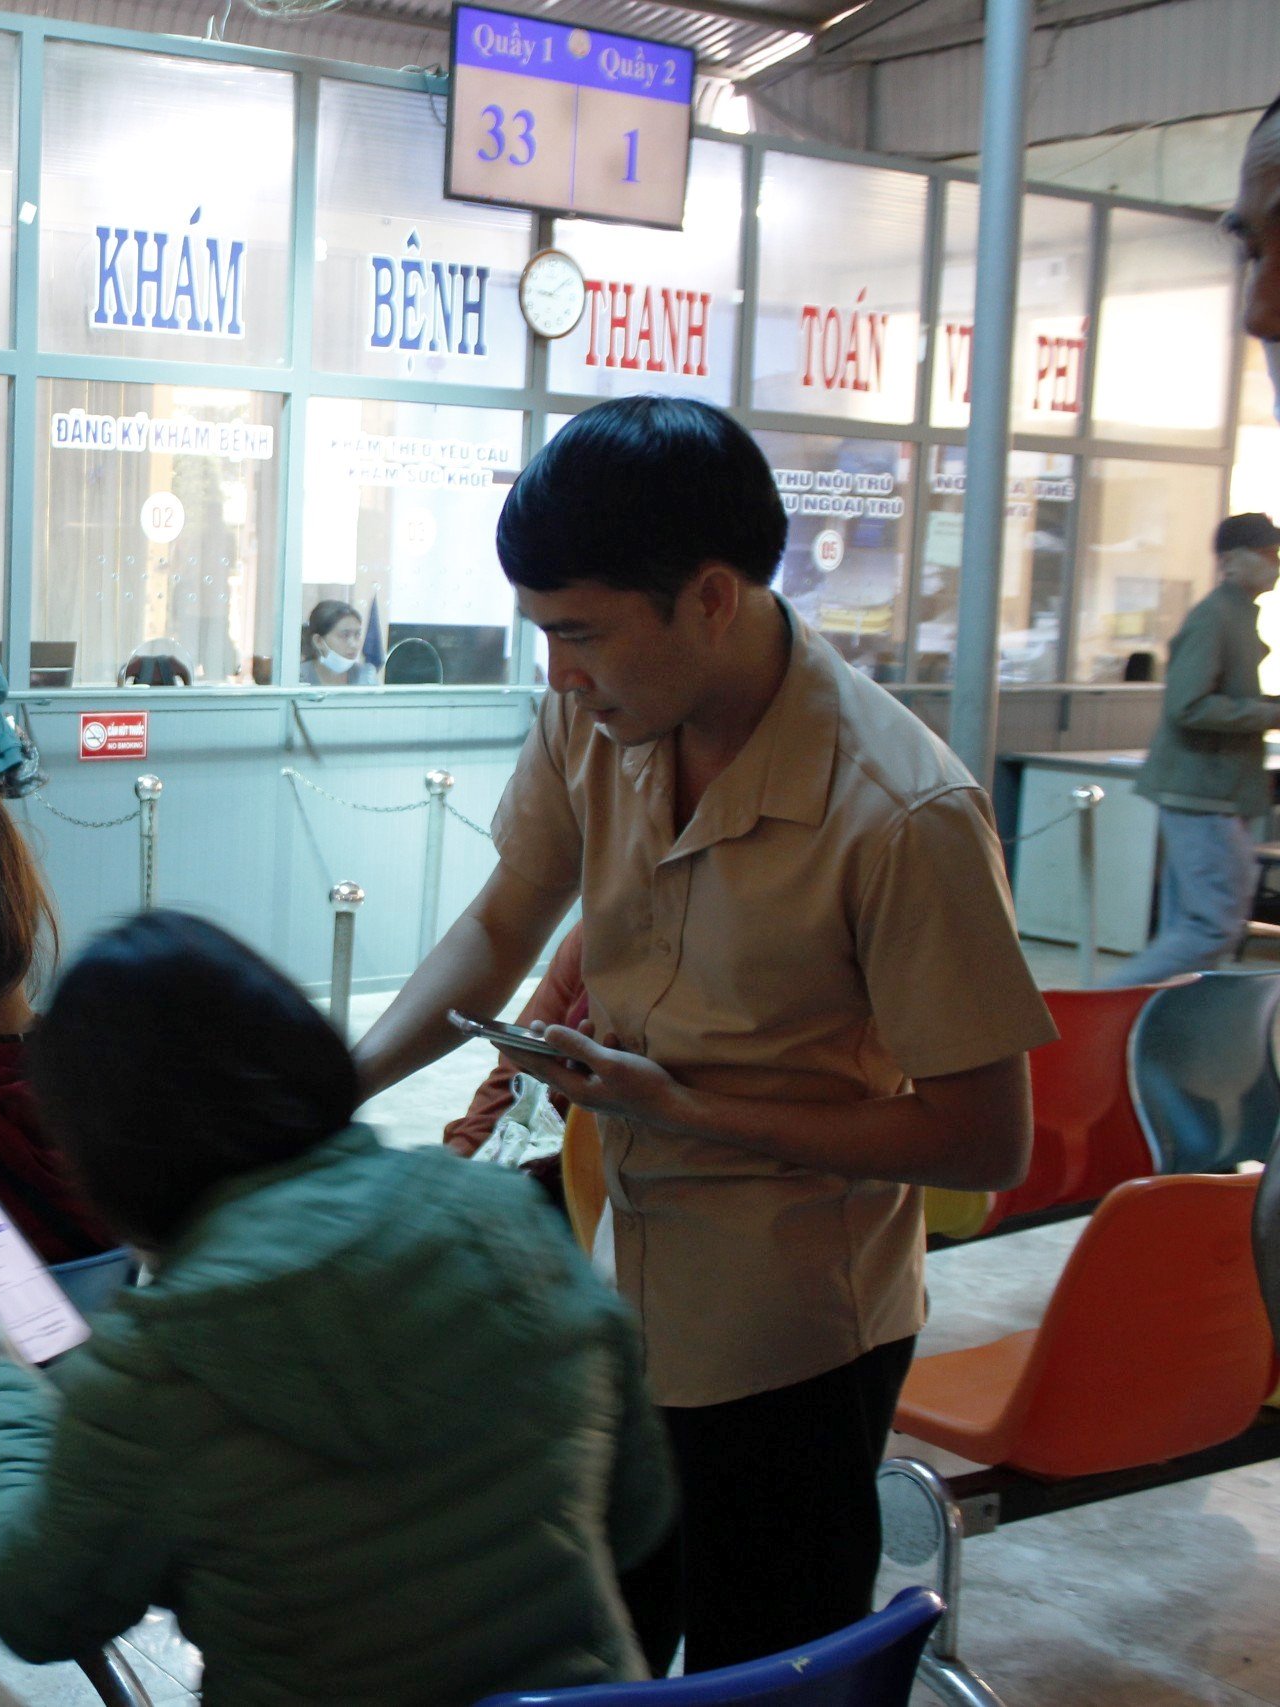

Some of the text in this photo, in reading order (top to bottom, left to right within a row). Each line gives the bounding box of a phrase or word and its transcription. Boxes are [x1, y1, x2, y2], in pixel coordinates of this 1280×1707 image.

[473, 22, 553, 65] Quầy 1
[600, 46, 676, 88] Quầy 2
[477, 104, 537, 166] 33
[621, 128, 640, 183] 1
[93, 204, 246, 335] KHÁM
[371, 229, 492, 374] BỆNH
[584, 278, 712, 378] THANH
[801, 286, 888, 394] TOÁN
[1033, 315, 1090, 413] PHÍ
[776, 473, 812, 488] THU
[856, 472, 893, 491] TRÚ
[869, 496, 902, 514] TRÚ
[152, 508, 174, 528] 02
[107, 741, 144, 750] NO SMOKING
